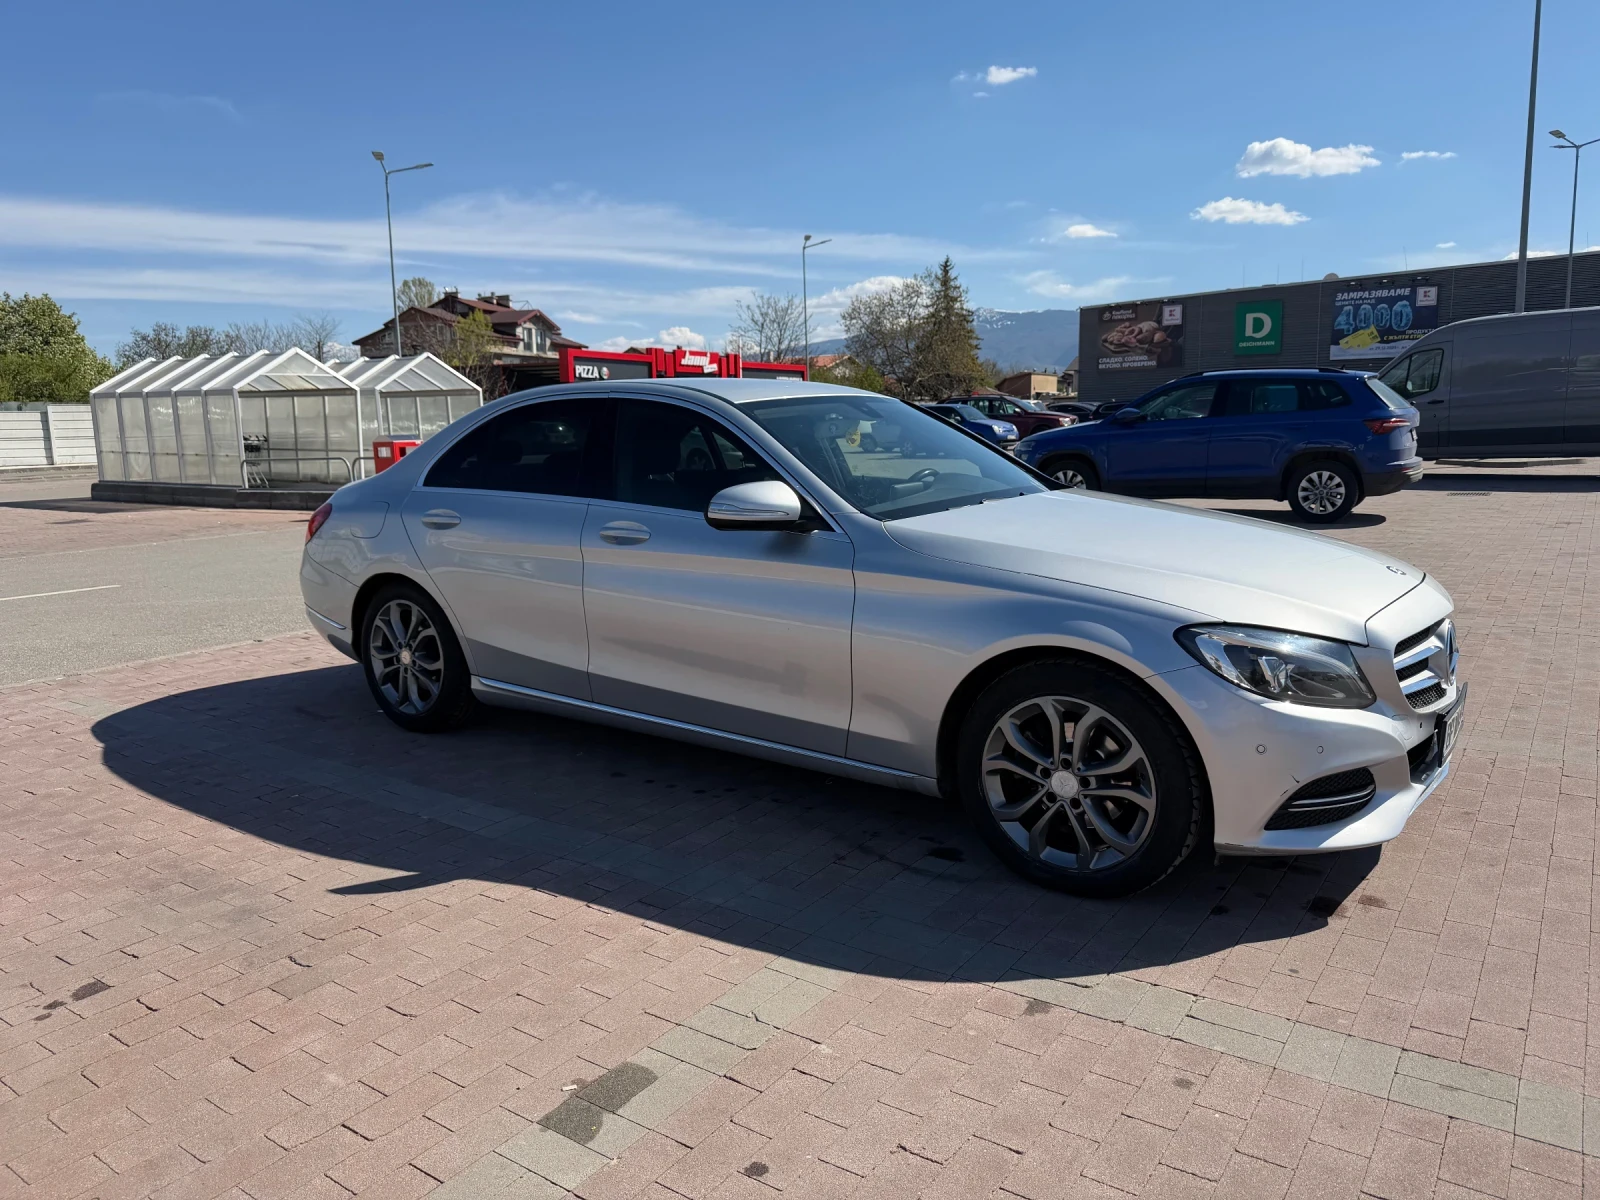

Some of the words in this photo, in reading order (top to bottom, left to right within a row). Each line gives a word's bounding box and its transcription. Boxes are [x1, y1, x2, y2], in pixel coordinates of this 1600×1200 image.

[1335, 288, 1411, 300] ЗАМРАЗЯВАМЕ
[1245, 312, 1272, 339] D
[1334, 300, 1413, 335] 4000
[575, 365, 600, 379] PIZZA
